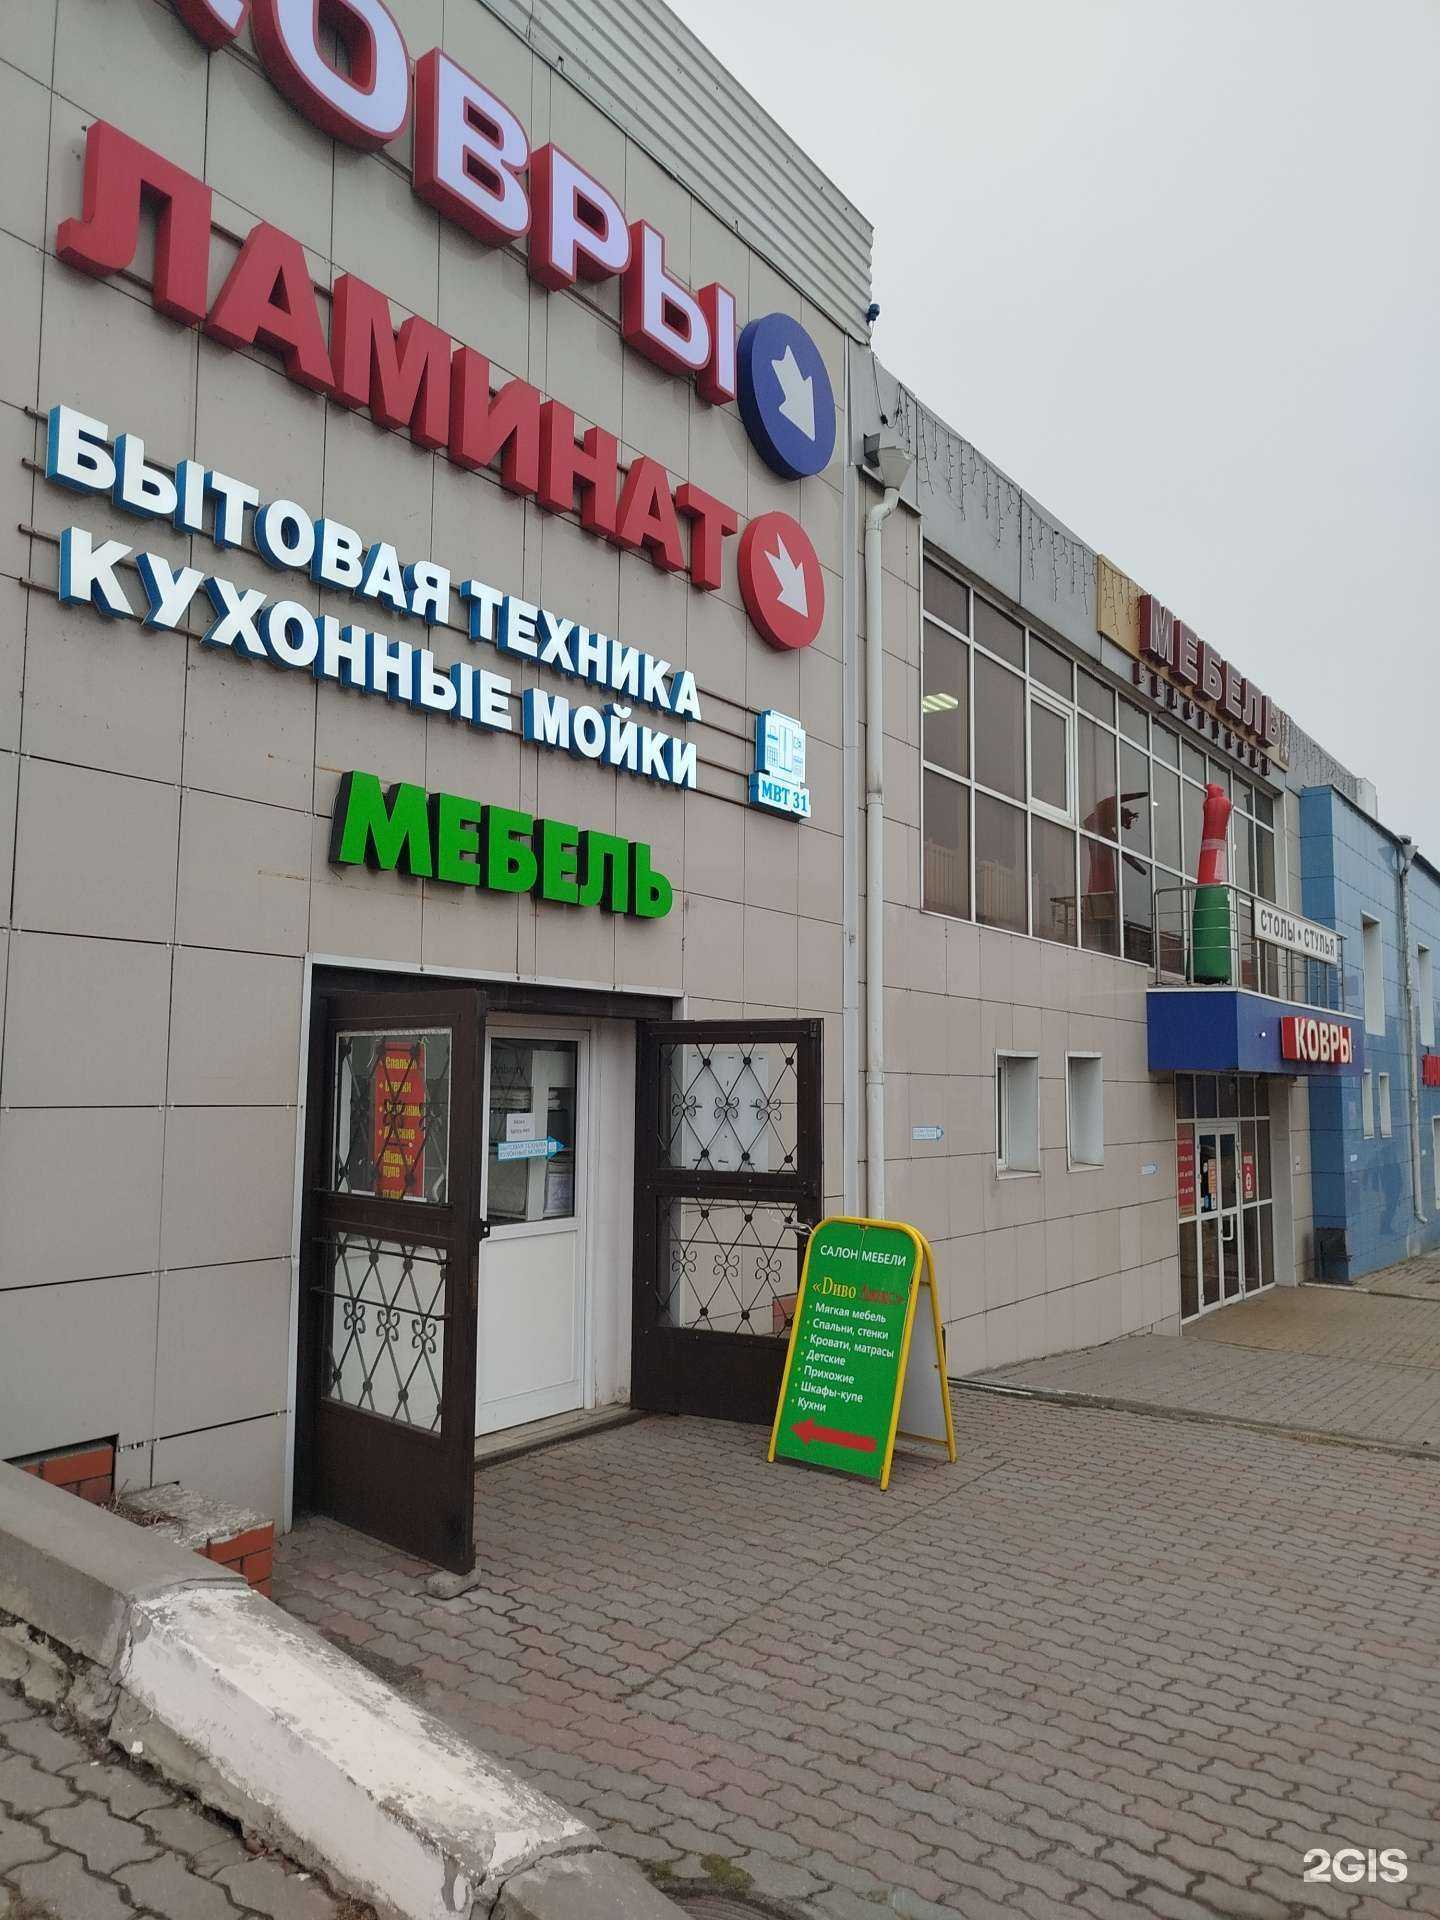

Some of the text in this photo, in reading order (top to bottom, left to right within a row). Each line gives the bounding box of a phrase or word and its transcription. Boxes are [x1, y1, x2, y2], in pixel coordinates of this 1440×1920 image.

[178, 0, 738, 405] ОВРЫ
[57, 120, 738, 591] ЛАМИНАТ
[46, 404, 702, 722] БЫТОВАЯ ТЕХНИКА
[58, 526, 699, 790] КУХОННЫЕ МОЙКИ
[1139, 593, 1281, 749] МЕБЕЛЬ
[792, 791, 808, 812] 31
[332, 770, 673, 918] МЕБЕЛЬ
[1260, 909, 1335, 957] СТОЛЫ СТУЛЬЯ
[1293, 1016, 1353, 1064] КОВРЫ
[820, 1244, 907, 1267] САЛОН МЕБЕЛИ
[815, 1302, 887, 1324] Мягкая мебель
[812, 1318, 889, 1341] Спальни, стенки
[805, 1349, 846, 1366] Детские
[809, 1333, 895, 1359] Кровати, матрасы
[803, 1365, 855, 1385] Прихожие
[797, 1396, 827, 1413] Кухни
[800, 1381, 864, 1404] Шкафы-купе
